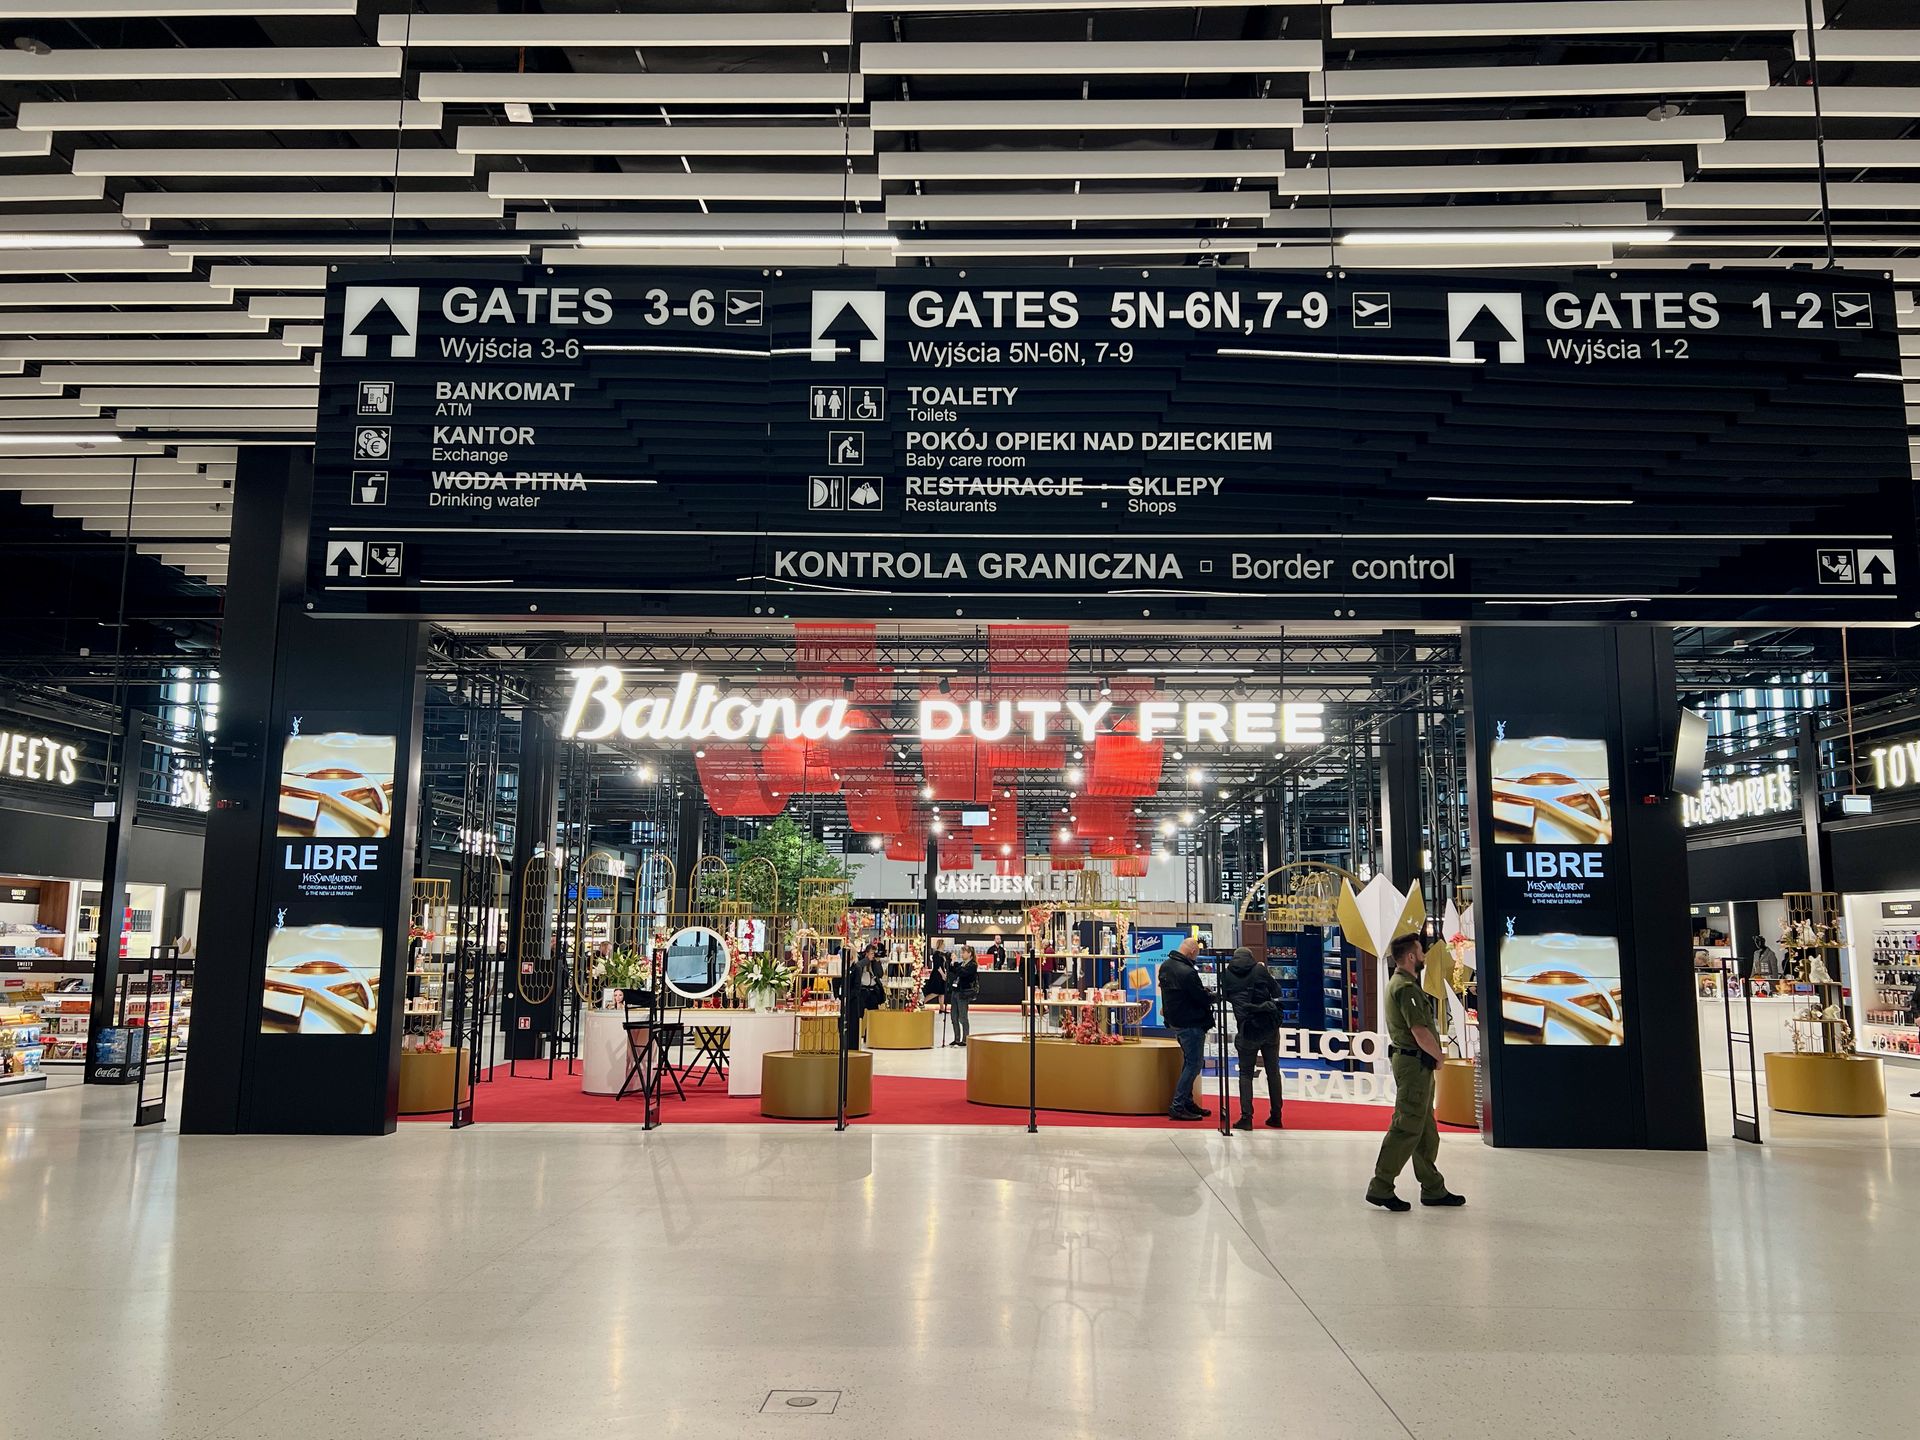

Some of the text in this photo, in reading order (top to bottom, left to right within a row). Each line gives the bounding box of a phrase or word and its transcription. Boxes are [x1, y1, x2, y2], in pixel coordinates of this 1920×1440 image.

[443, 287, 714, 325] GATES 3-6
[909, 291, 1078, 328] GATES
[1546, 292, 1823, 329] GATES 1-2
[440, 338, 579, 363] Wyjścia 3-6
[909, 342, 1133, 367] Wyjścia 5N-6N, 7-9
[1547, 339, 1688, 364] Wyjścia 1-2
[435, 382, 575, 401] BANKOMAT
[908, 387, 1018, 406] TOALETY
[435, 403, 472, 417] ATM
[907, 408, 957, 422] Toilets
[434, 427, 534, 444] KANTOR
[906, 428, 1273, 451] POKÓJ OPIEKI NAD DZIECKIEM
[432, 448, 508, 465] Exchange
[906, 454, 1026, 470] Baby care room
[432, 471, 588, 491] WODA PITNA
[905, 477, 1225, 496] RESTAURACJE SKLEPY
[429, 493, 540, 510] Drinking water
[905, 498, 1177, 515] Restaurants Shops
[774, 552, 1455, 581] KONTROLA GRANICZNA Border control
[561, 665, 1326, 744] Baltona DUTY FREE
[285, 845, 378, 870] LIBRE
[1506, 852, 1604, 877] LIBRE
[934, 875, 981, 894] CASH
[989, 876, 1035, 894] DESK
[960, 915, 1023, 925] TRAVEL CHEF
